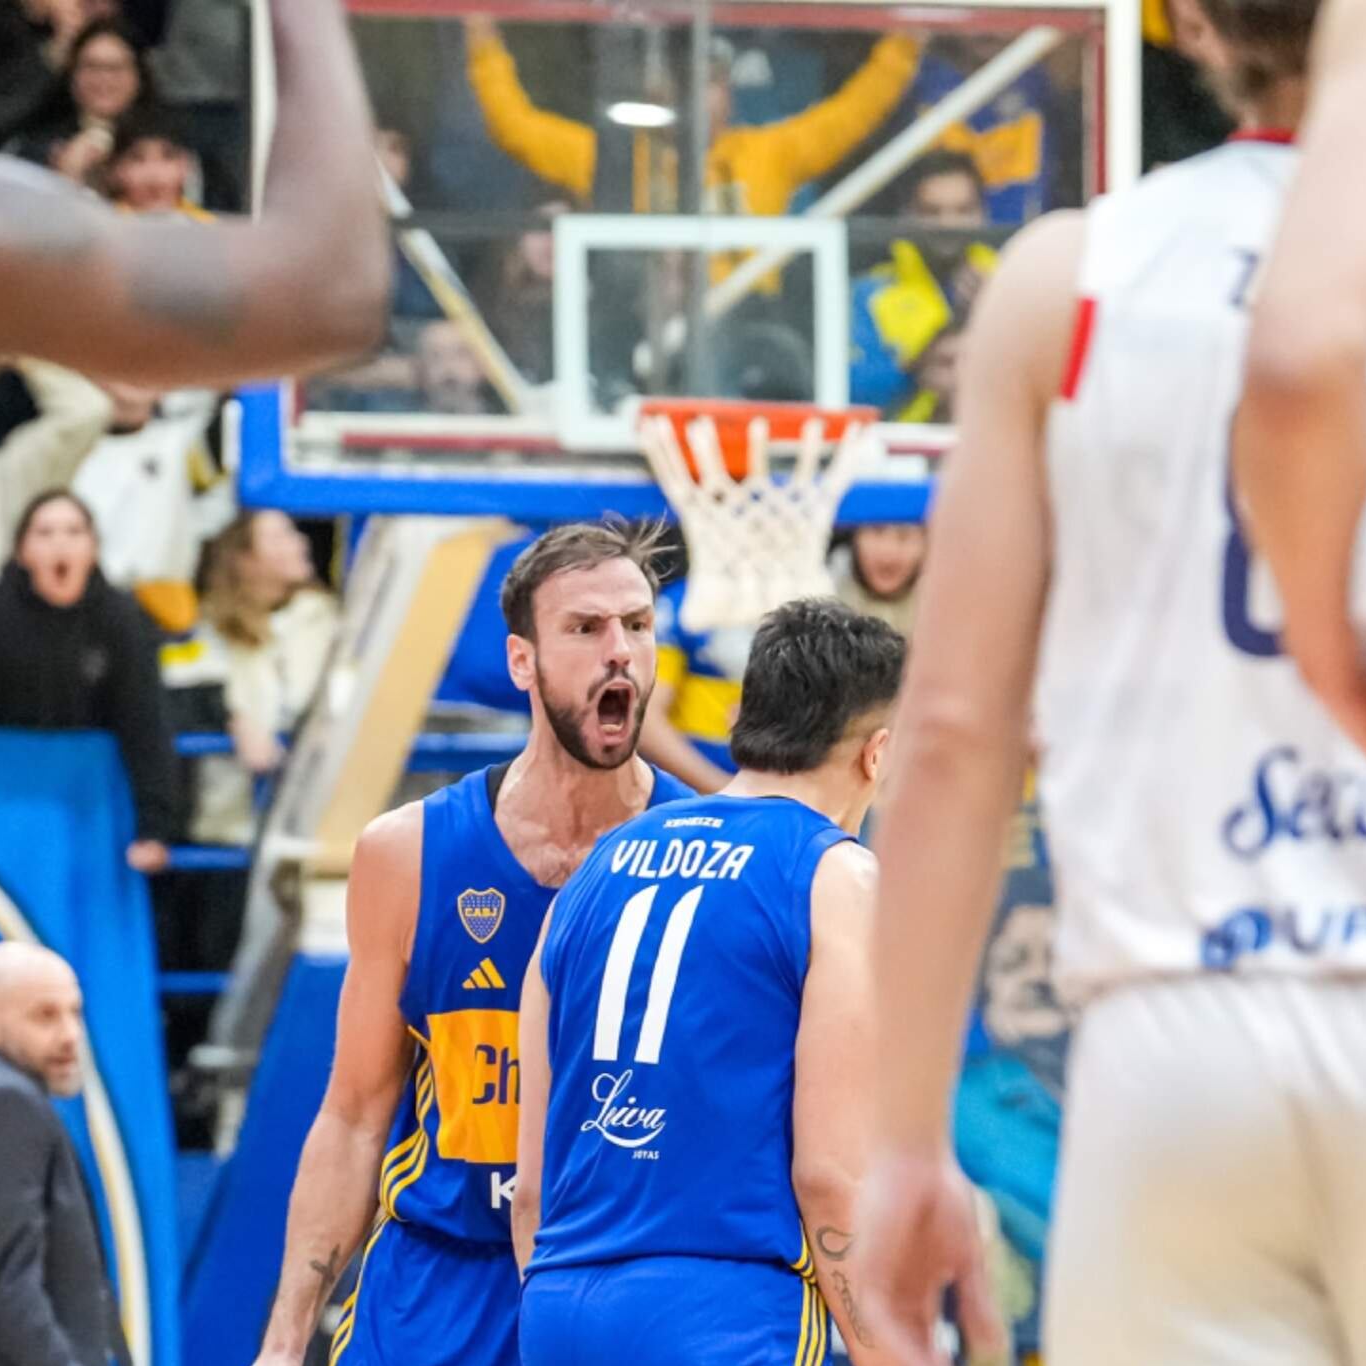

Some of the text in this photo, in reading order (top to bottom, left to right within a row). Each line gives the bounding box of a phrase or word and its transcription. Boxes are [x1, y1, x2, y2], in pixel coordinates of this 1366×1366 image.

[611, 838, 755, 880] VILDOZA
[592, 885, 703, 1065] 11
[580, 1068, 667, 1148] Leiva
